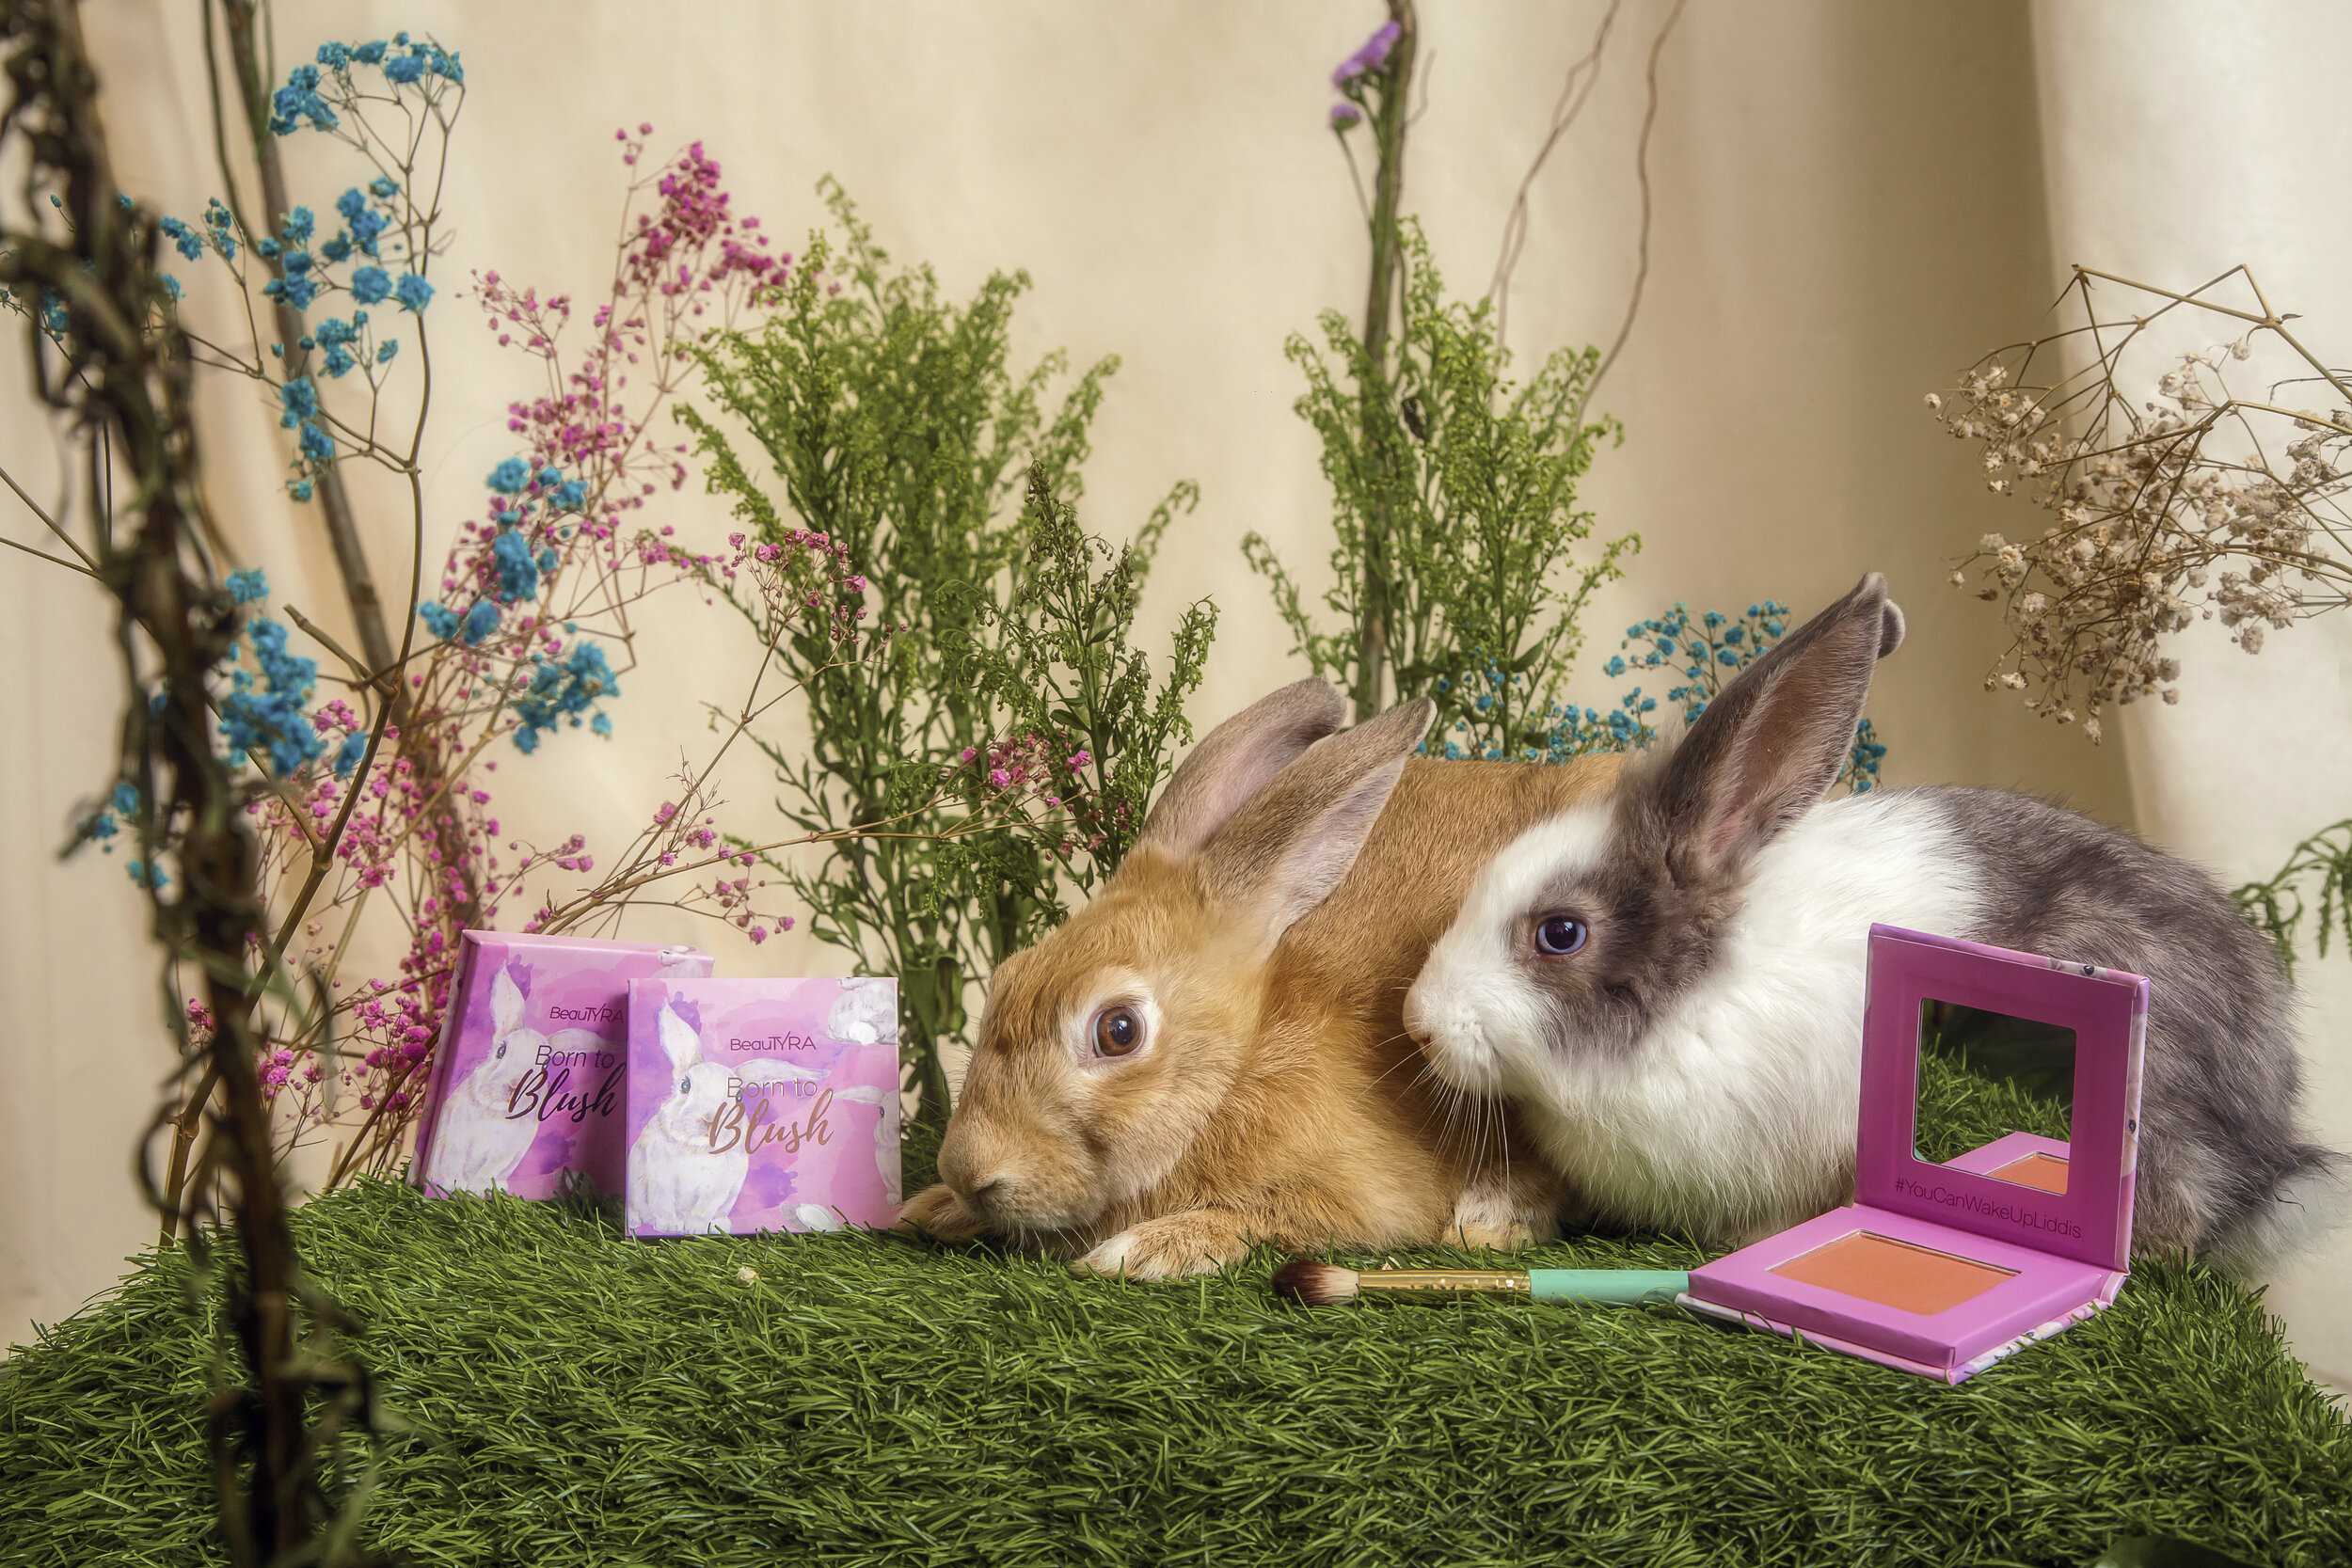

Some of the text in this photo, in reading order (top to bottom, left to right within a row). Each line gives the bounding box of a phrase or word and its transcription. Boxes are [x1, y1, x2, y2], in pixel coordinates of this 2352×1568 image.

[549, 1003, 625, 1023] BeauTYRA
[729, 1031, 817, 1051] BeauTYRA
[534, 1045, 615, 1069] Born to
[504, 1061, 628, 1123] Blush
[726, 1077, 818, 1098] Born to
[707, 1087, 834, 1155] Blush
[1894, 1177, 2082, 1239] #YouCanWakeUpLiddis
